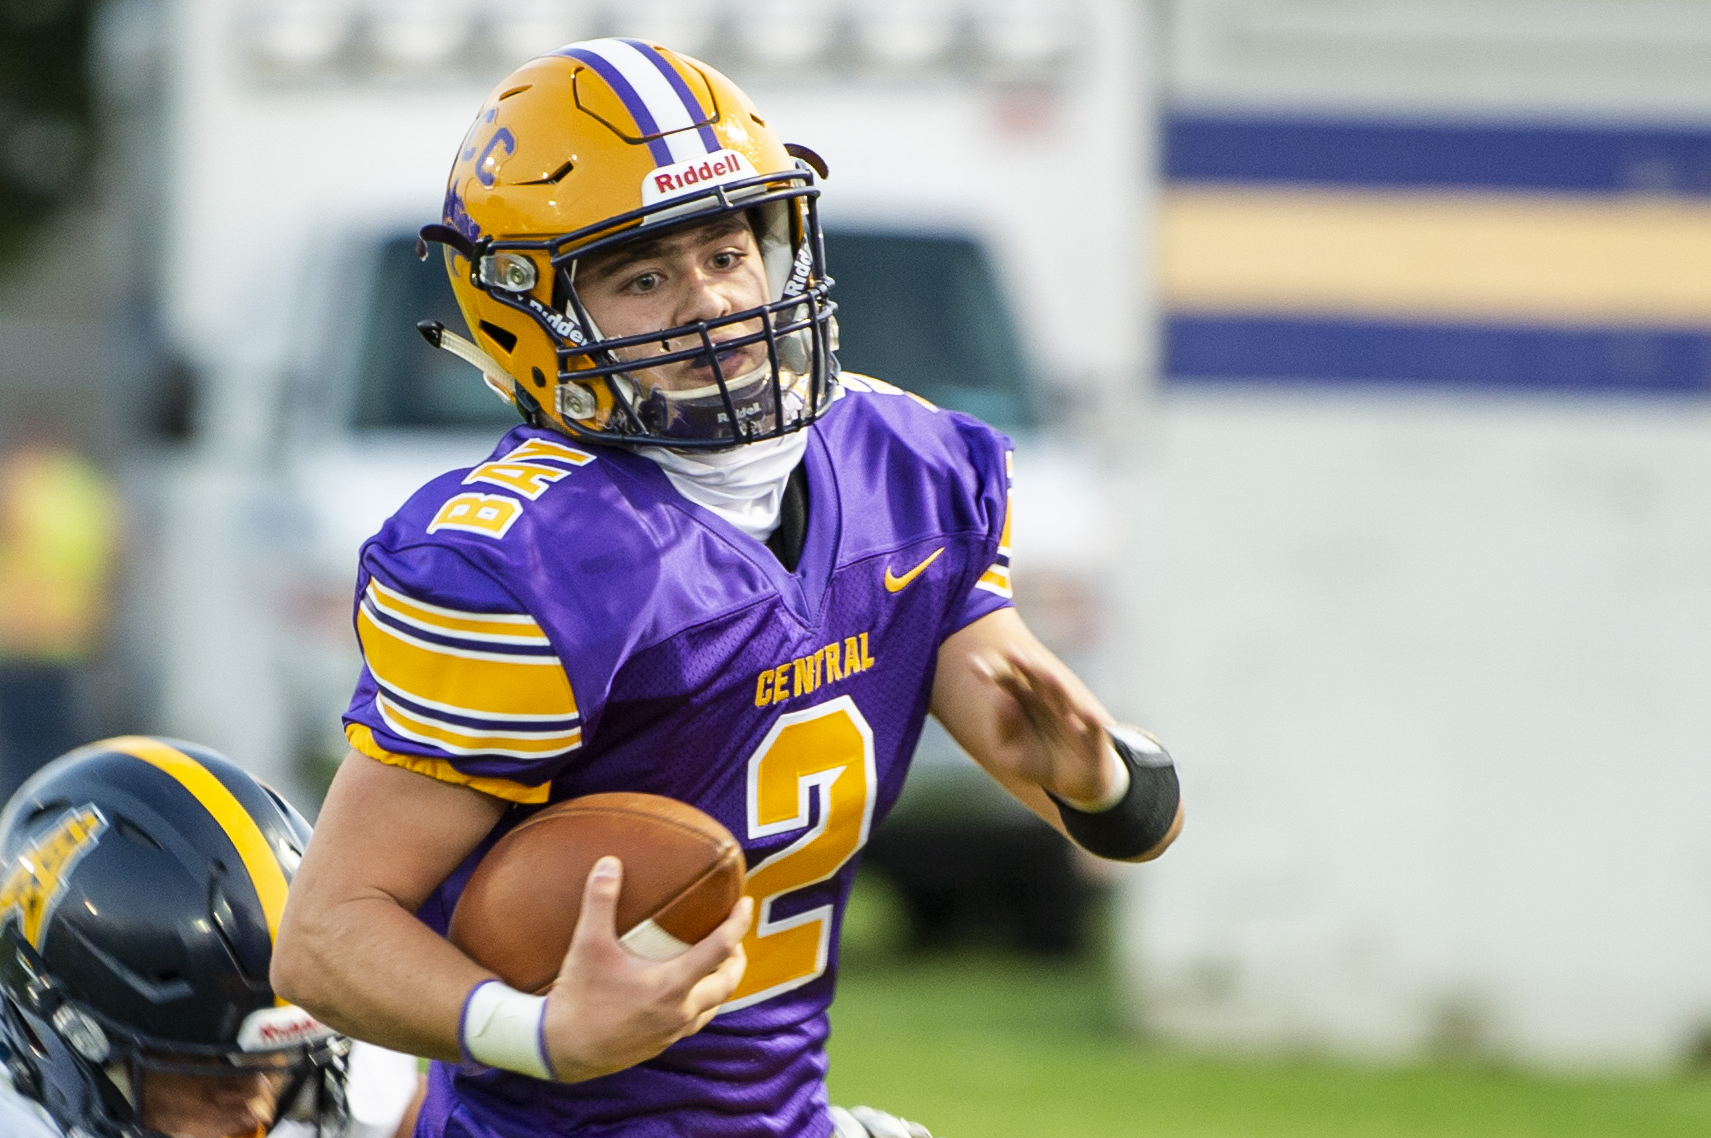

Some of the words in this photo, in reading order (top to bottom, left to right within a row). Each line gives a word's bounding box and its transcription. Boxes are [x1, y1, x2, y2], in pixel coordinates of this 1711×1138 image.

[653, 153, 741, 195] Riddell
[425, 437, 598, 541] BAY
[754, 631, 875, 708] CENTRAL
[716, 694, 878, 1015] 2
